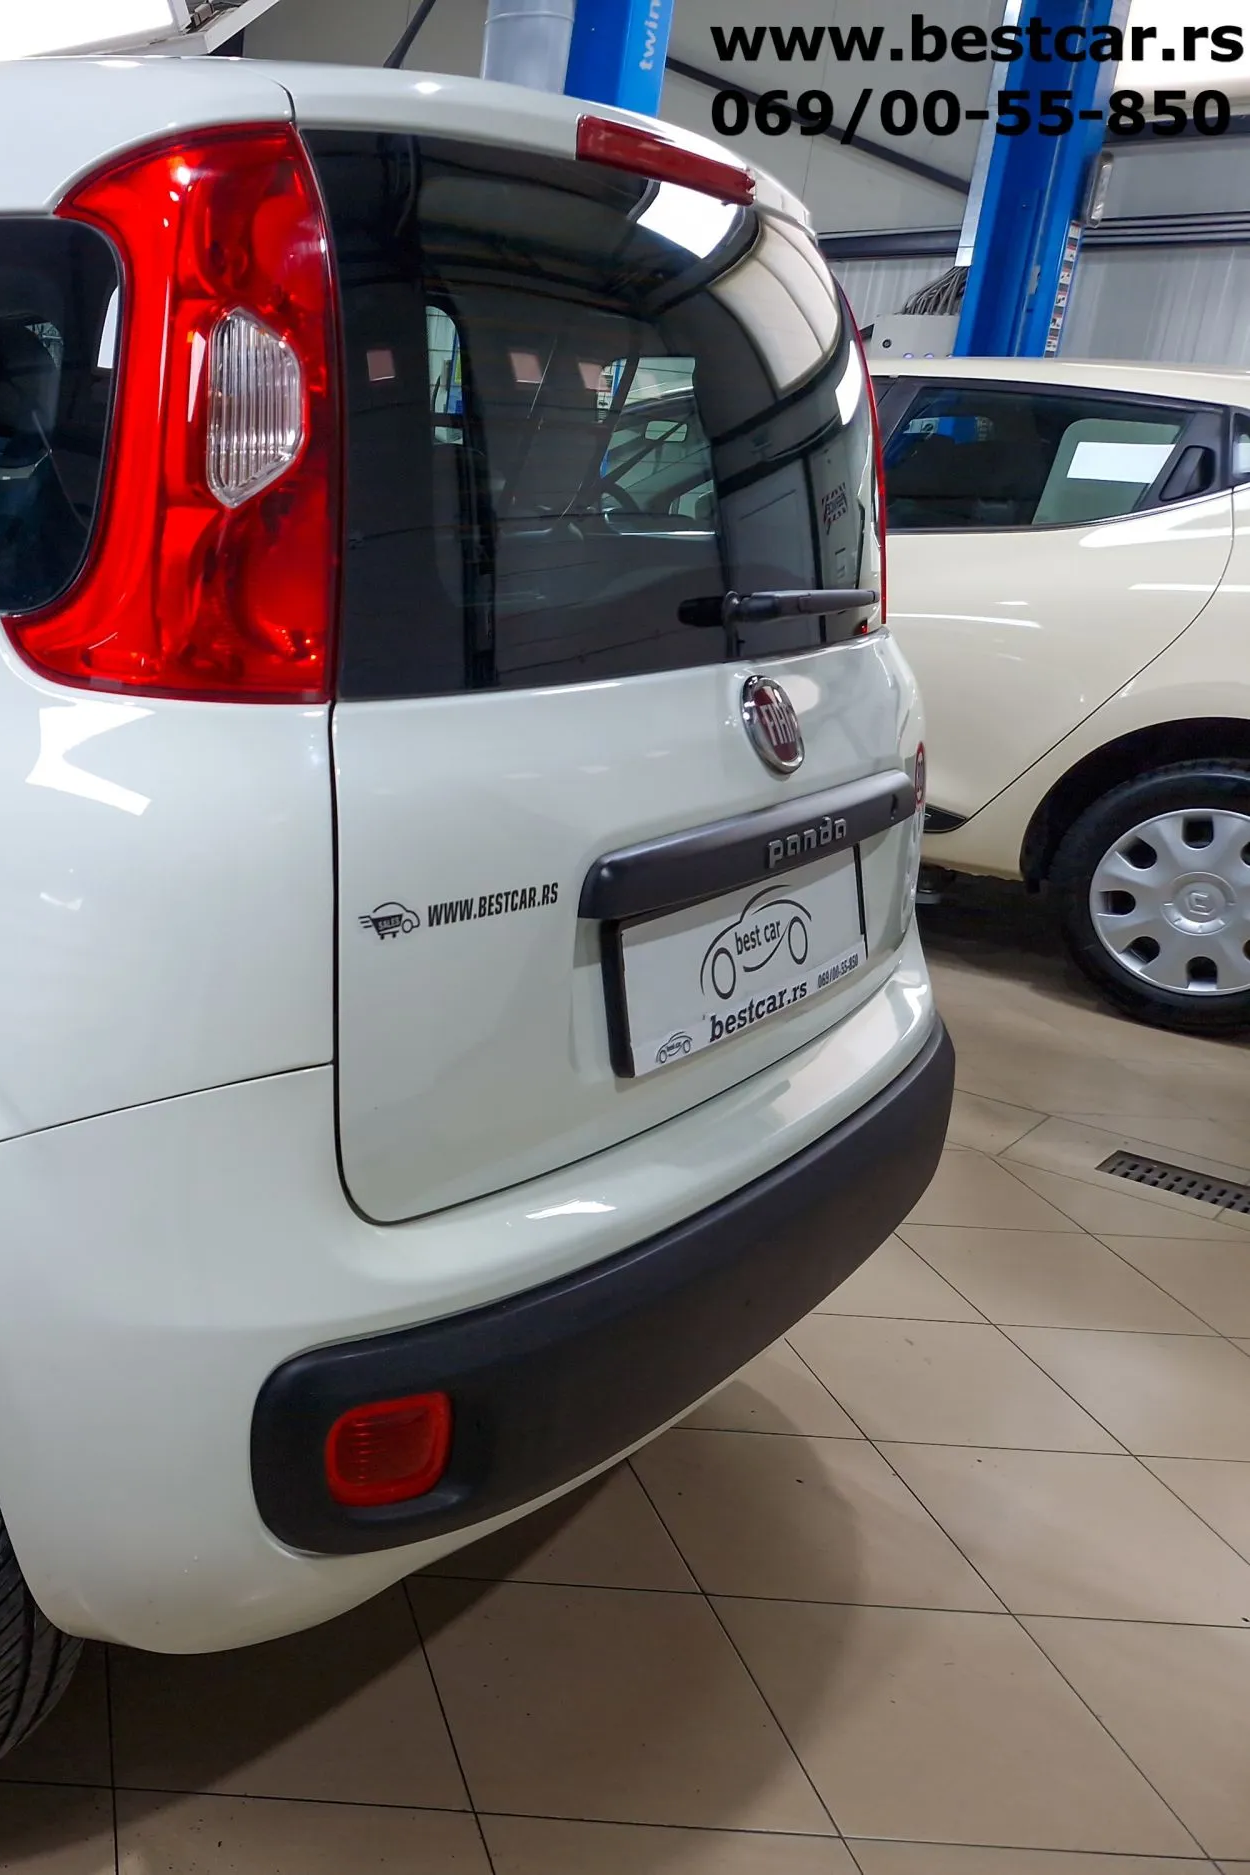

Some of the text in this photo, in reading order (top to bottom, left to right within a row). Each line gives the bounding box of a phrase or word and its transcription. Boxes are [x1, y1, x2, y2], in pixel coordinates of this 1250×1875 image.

[768, 815, 848, 869] panda
[427, 882, 559, 927] WWW.BESTCAR.RS
[734, 920, 782, 955] best car
[709, 981, 808, 1043] bestcar.rs
